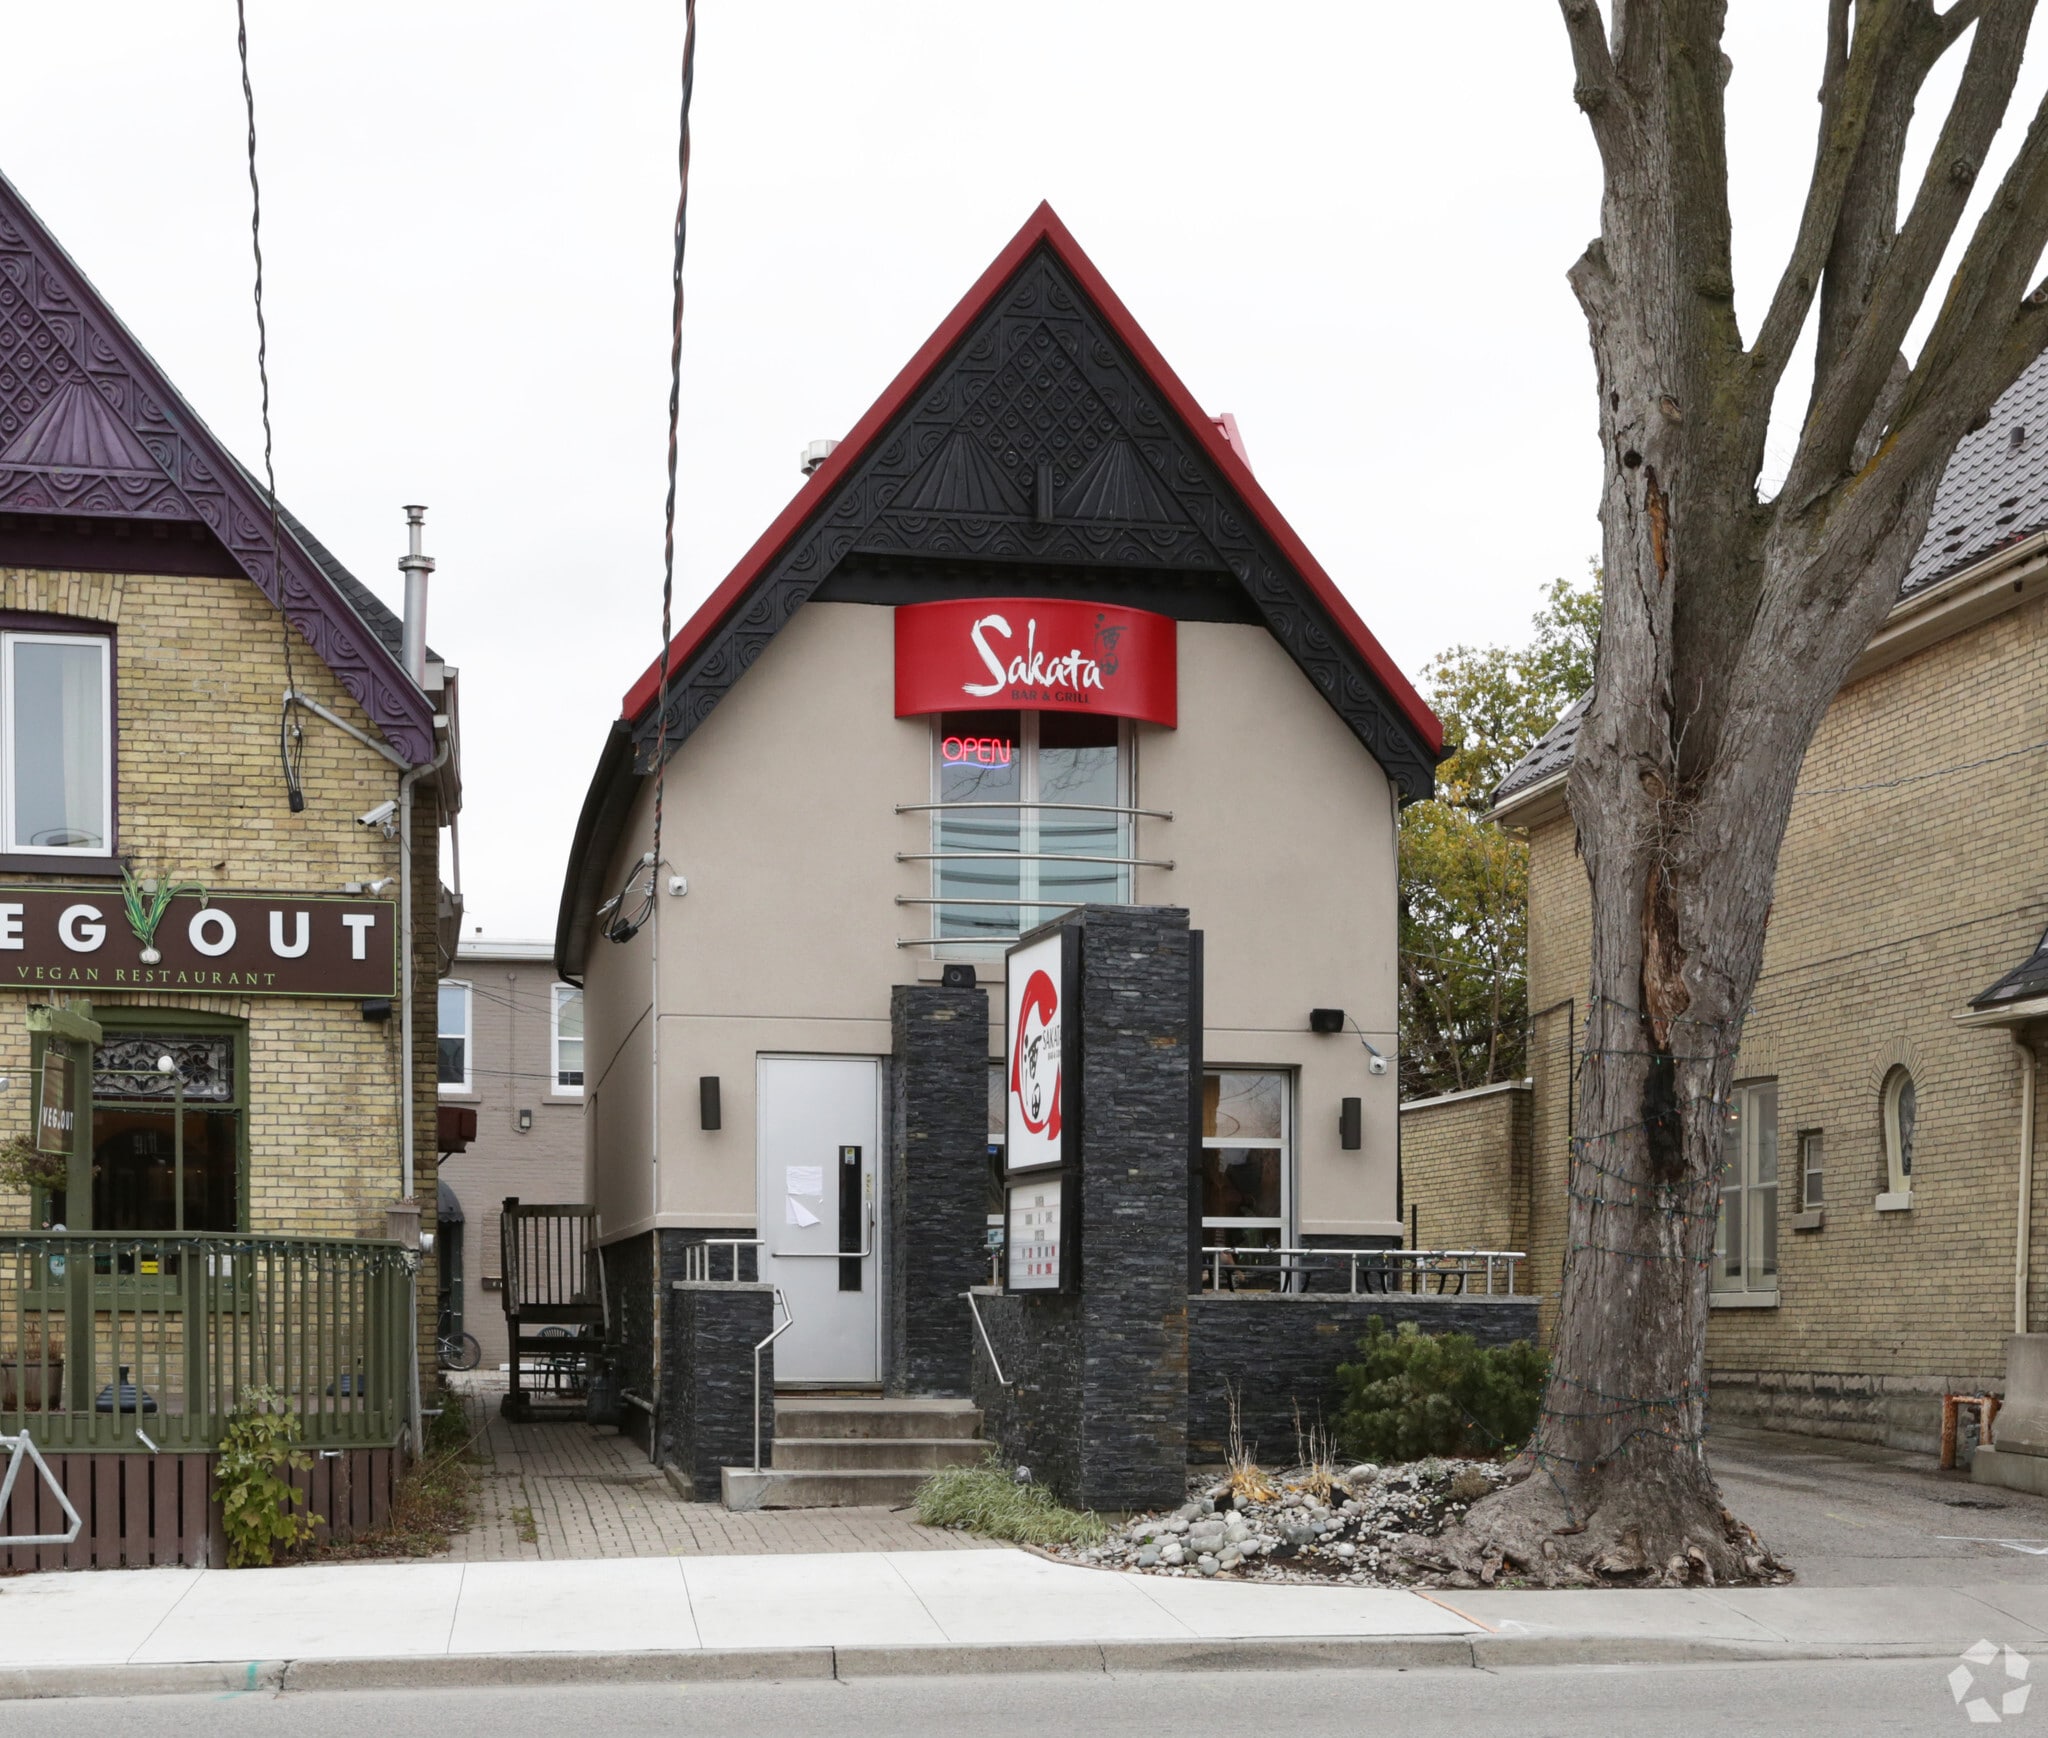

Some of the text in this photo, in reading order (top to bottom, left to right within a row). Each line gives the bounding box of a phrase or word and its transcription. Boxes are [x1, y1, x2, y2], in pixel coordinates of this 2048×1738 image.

[962, 614, 1104, 697] Sakata
[1012, 690, 1090, 704] BAR & GRILL
[942, 737, 1011, 763] OPEN
[188, 908, 375, 960] OUT
[17, 966, 277, 986] VEGAN RESTAURANT
[1042, 1024, 1061, 1050] SAKAT
